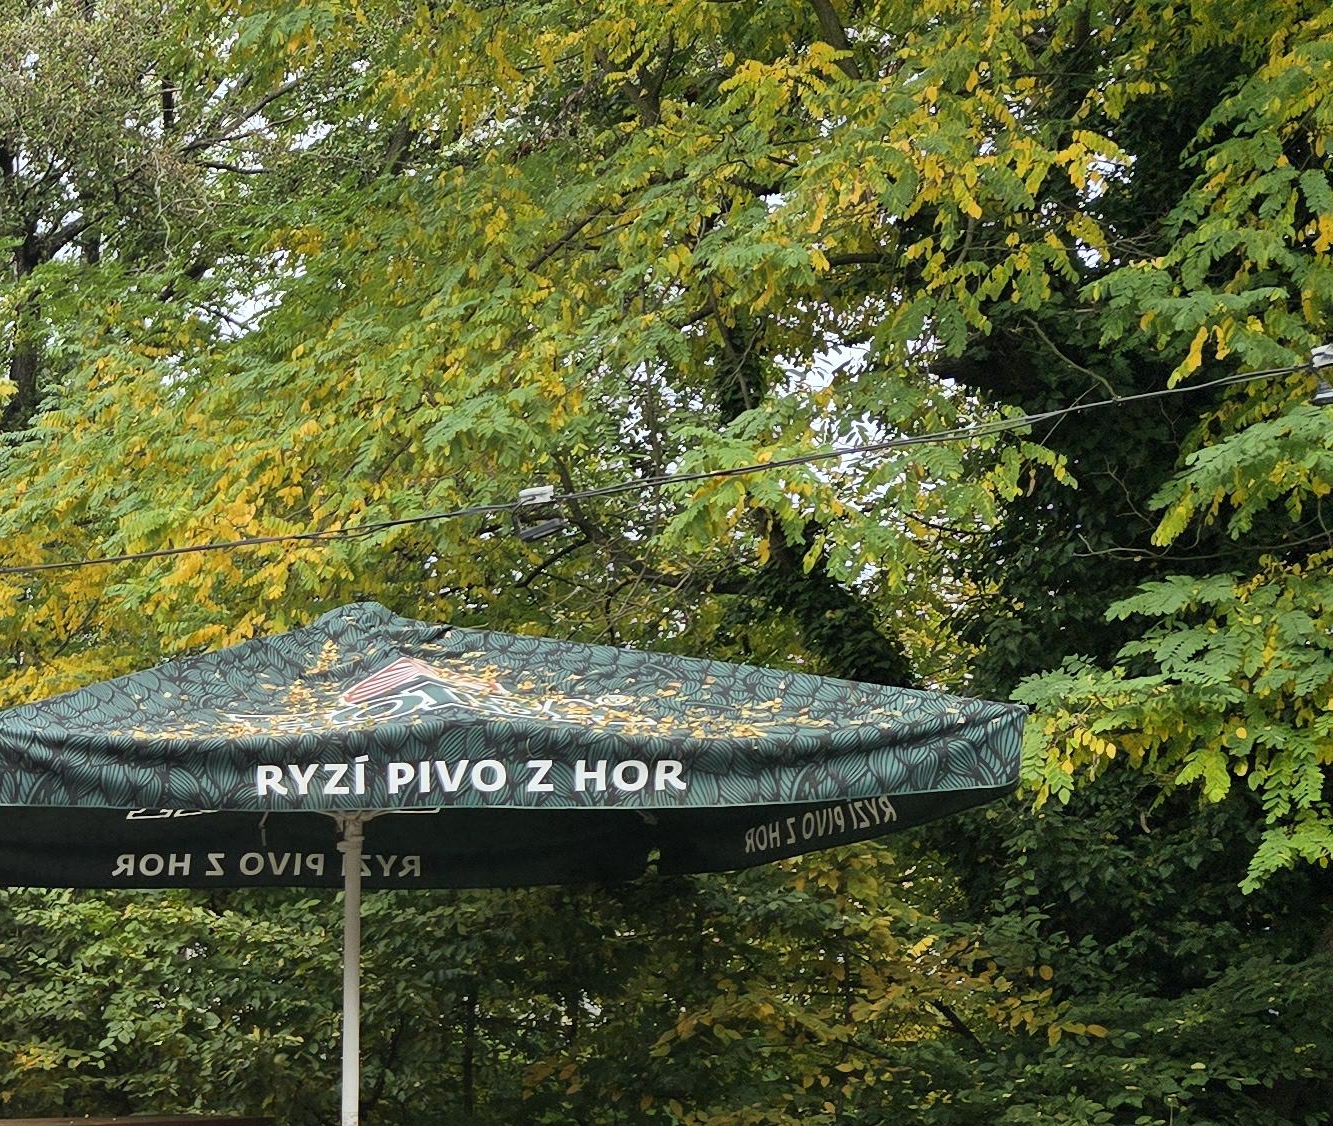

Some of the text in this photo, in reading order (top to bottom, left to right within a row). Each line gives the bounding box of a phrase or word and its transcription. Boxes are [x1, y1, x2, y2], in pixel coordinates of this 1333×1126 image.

[256, 754, 688, 796] RYZÍ PIVO Z HOR
